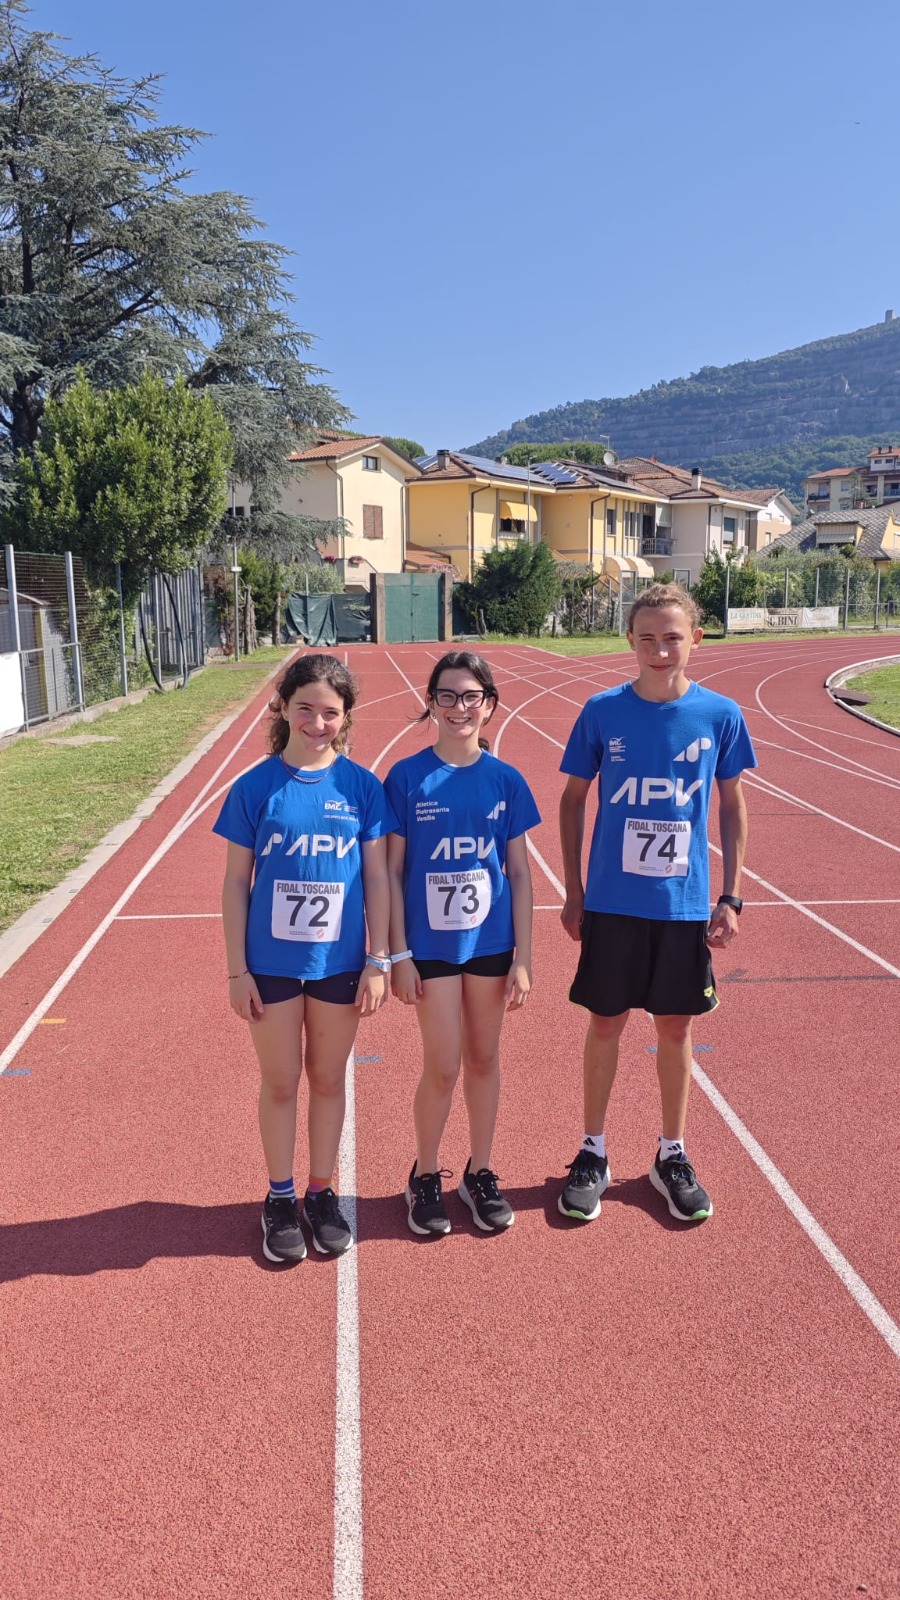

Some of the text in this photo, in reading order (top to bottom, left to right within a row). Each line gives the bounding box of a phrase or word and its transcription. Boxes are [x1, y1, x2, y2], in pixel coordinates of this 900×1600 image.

[610, 777, 704, 806] APV
[628, 820, 687, 832] FIDAL TOSCANA
[285, 834, 356, 858] APV
[430, 836, 495, 860] APV
[637, 832, 677, 863] 74
[276, 883, 340, 894] FIDAL TOSCANA
[428, 871, 486, 885] FIDAL TOSCANA
[286, 895, 329, 927] 72
[438, 884, 479, 916] 73
